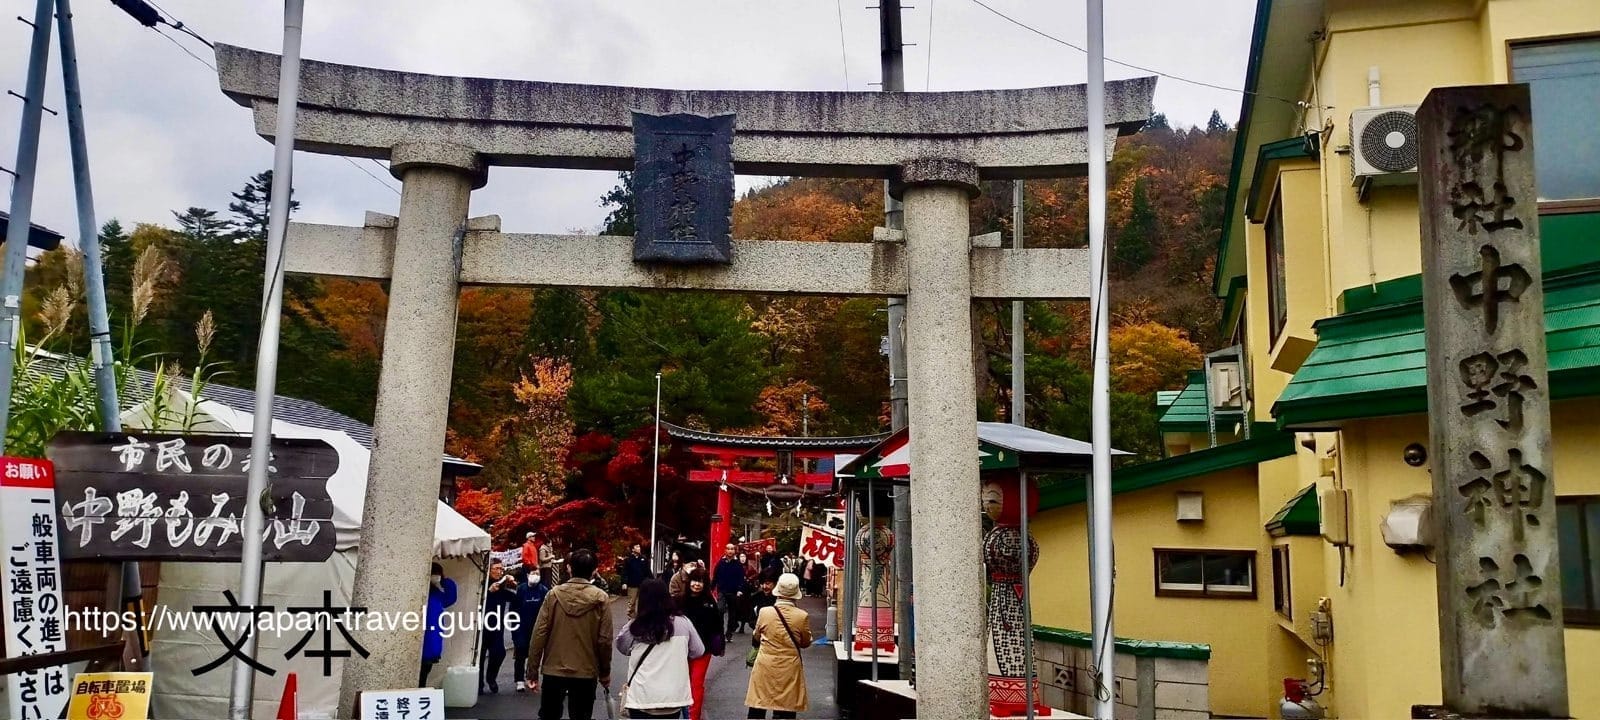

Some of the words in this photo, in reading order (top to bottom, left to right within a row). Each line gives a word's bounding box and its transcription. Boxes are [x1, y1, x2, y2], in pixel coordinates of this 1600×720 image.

[5, 462, 47, 480] お願い
[31, 498, 64, 696] 一般車両の進は
[76, 680, 146, 695] 自転車置場
